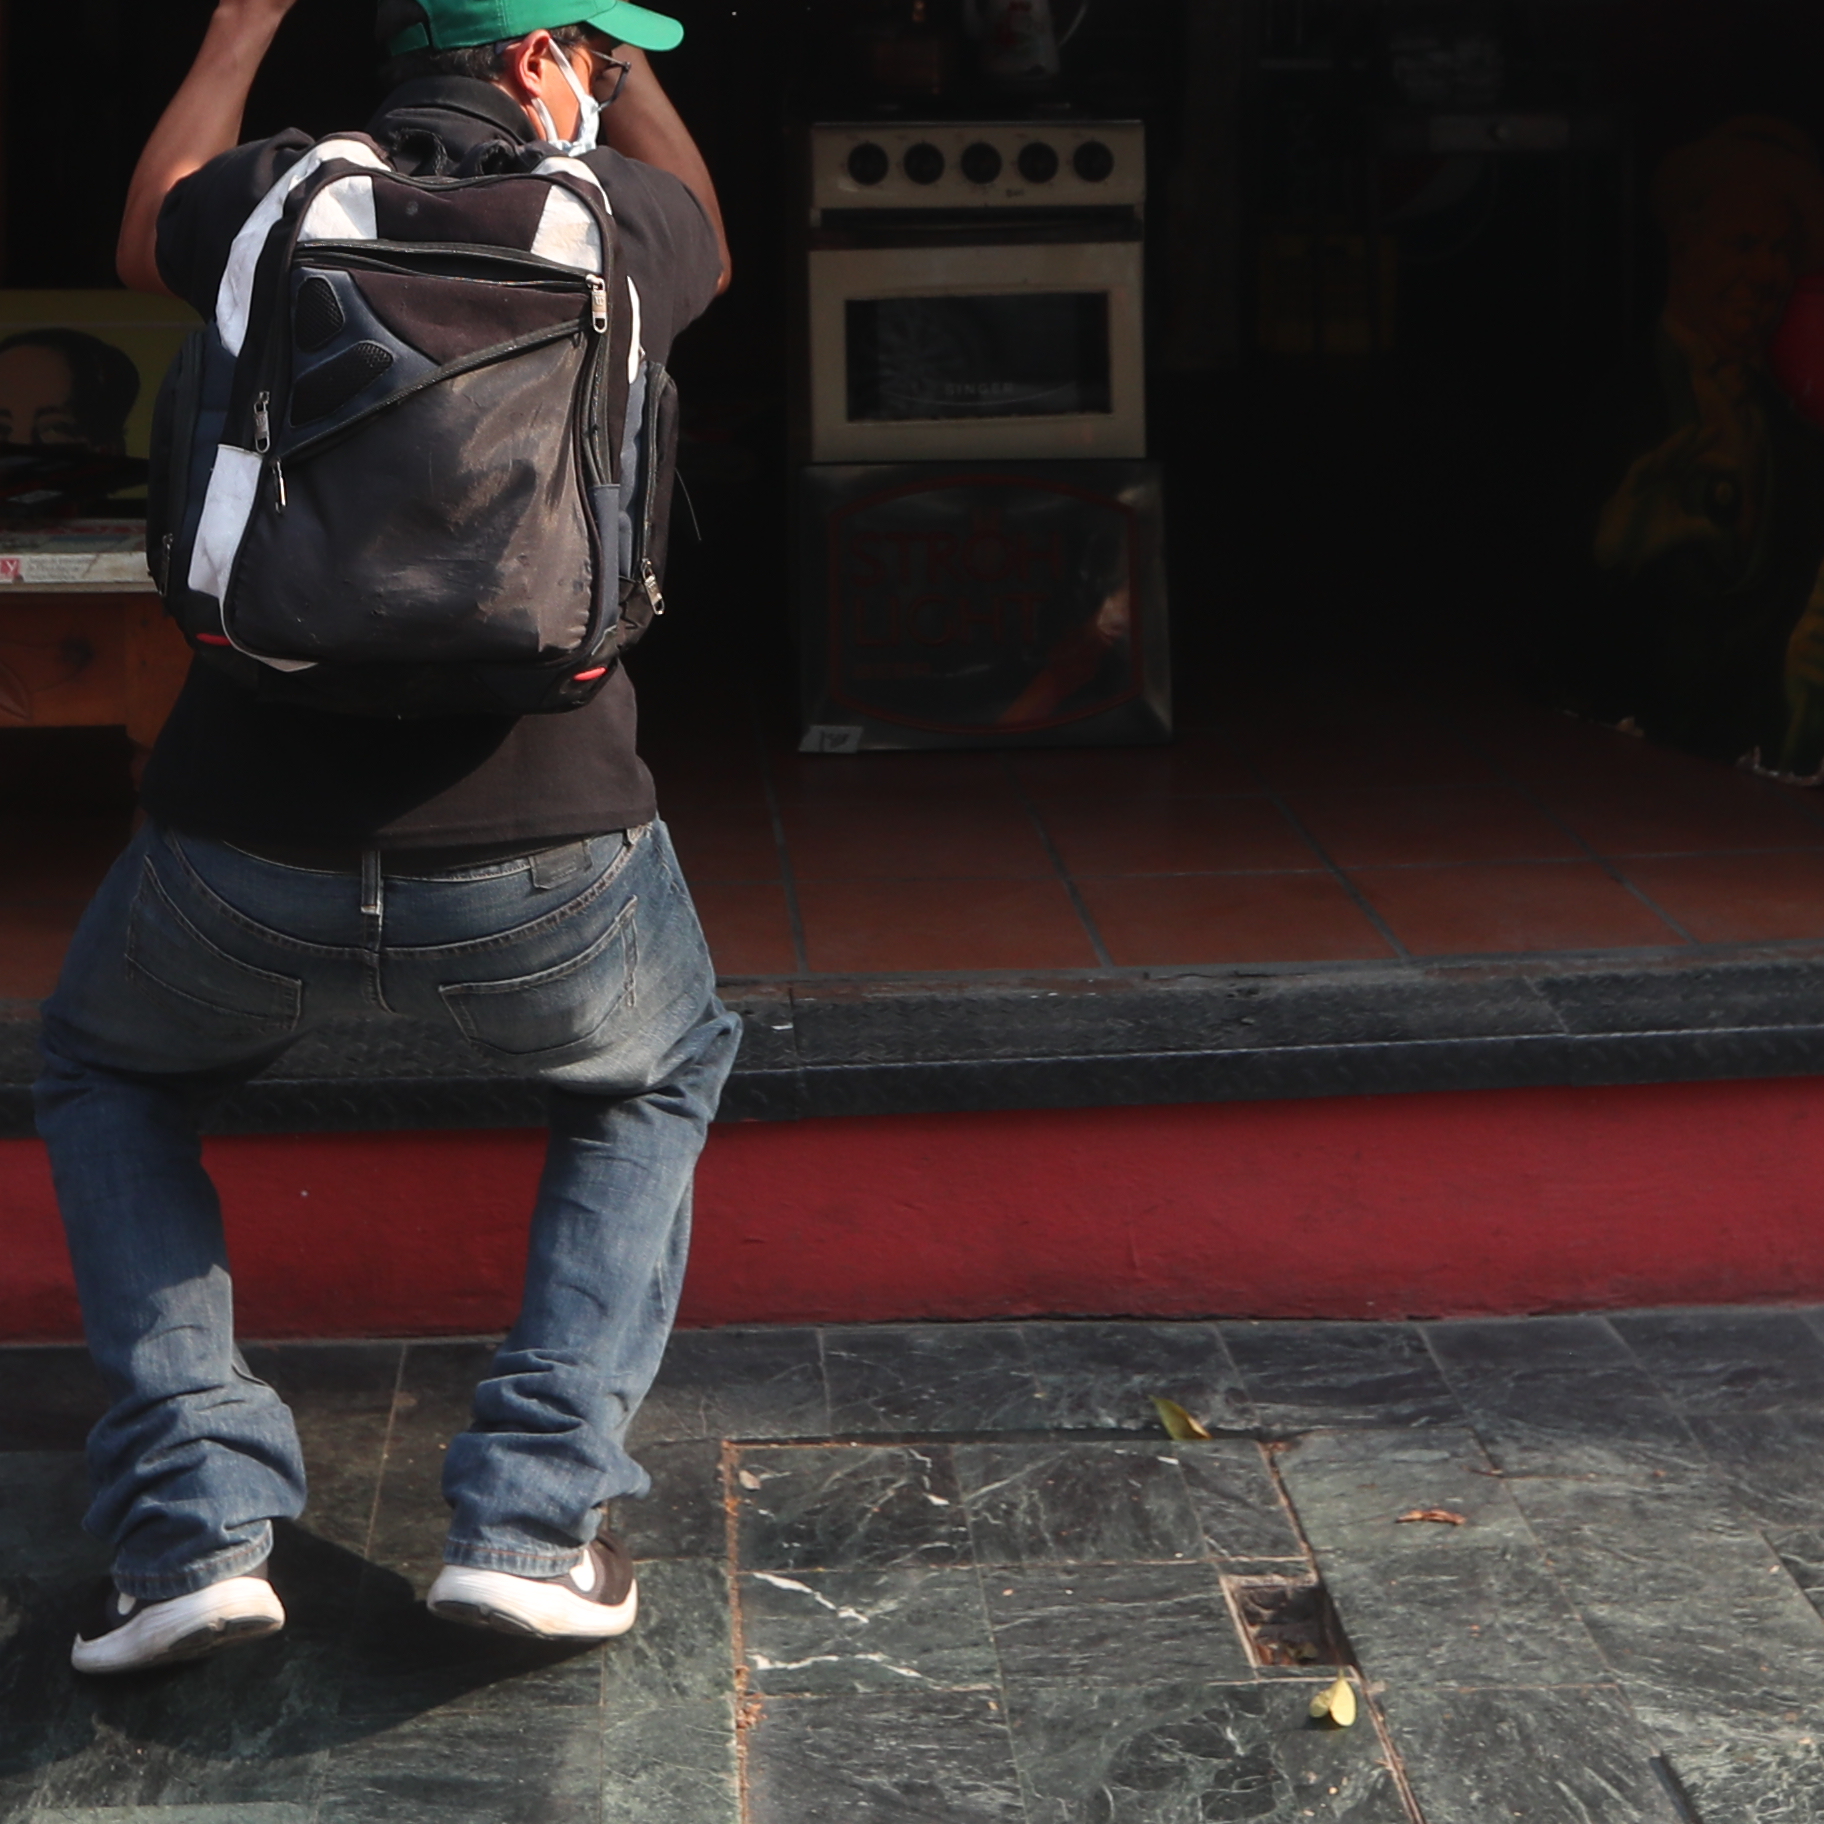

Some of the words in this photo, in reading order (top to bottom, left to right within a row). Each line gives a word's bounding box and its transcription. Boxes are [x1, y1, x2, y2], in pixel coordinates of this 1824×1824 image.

[944, 381, 1014, 396] SINGER
[849, 529, 1064, 588] STROH
[853, 591, 1051, 647] LIGHT
